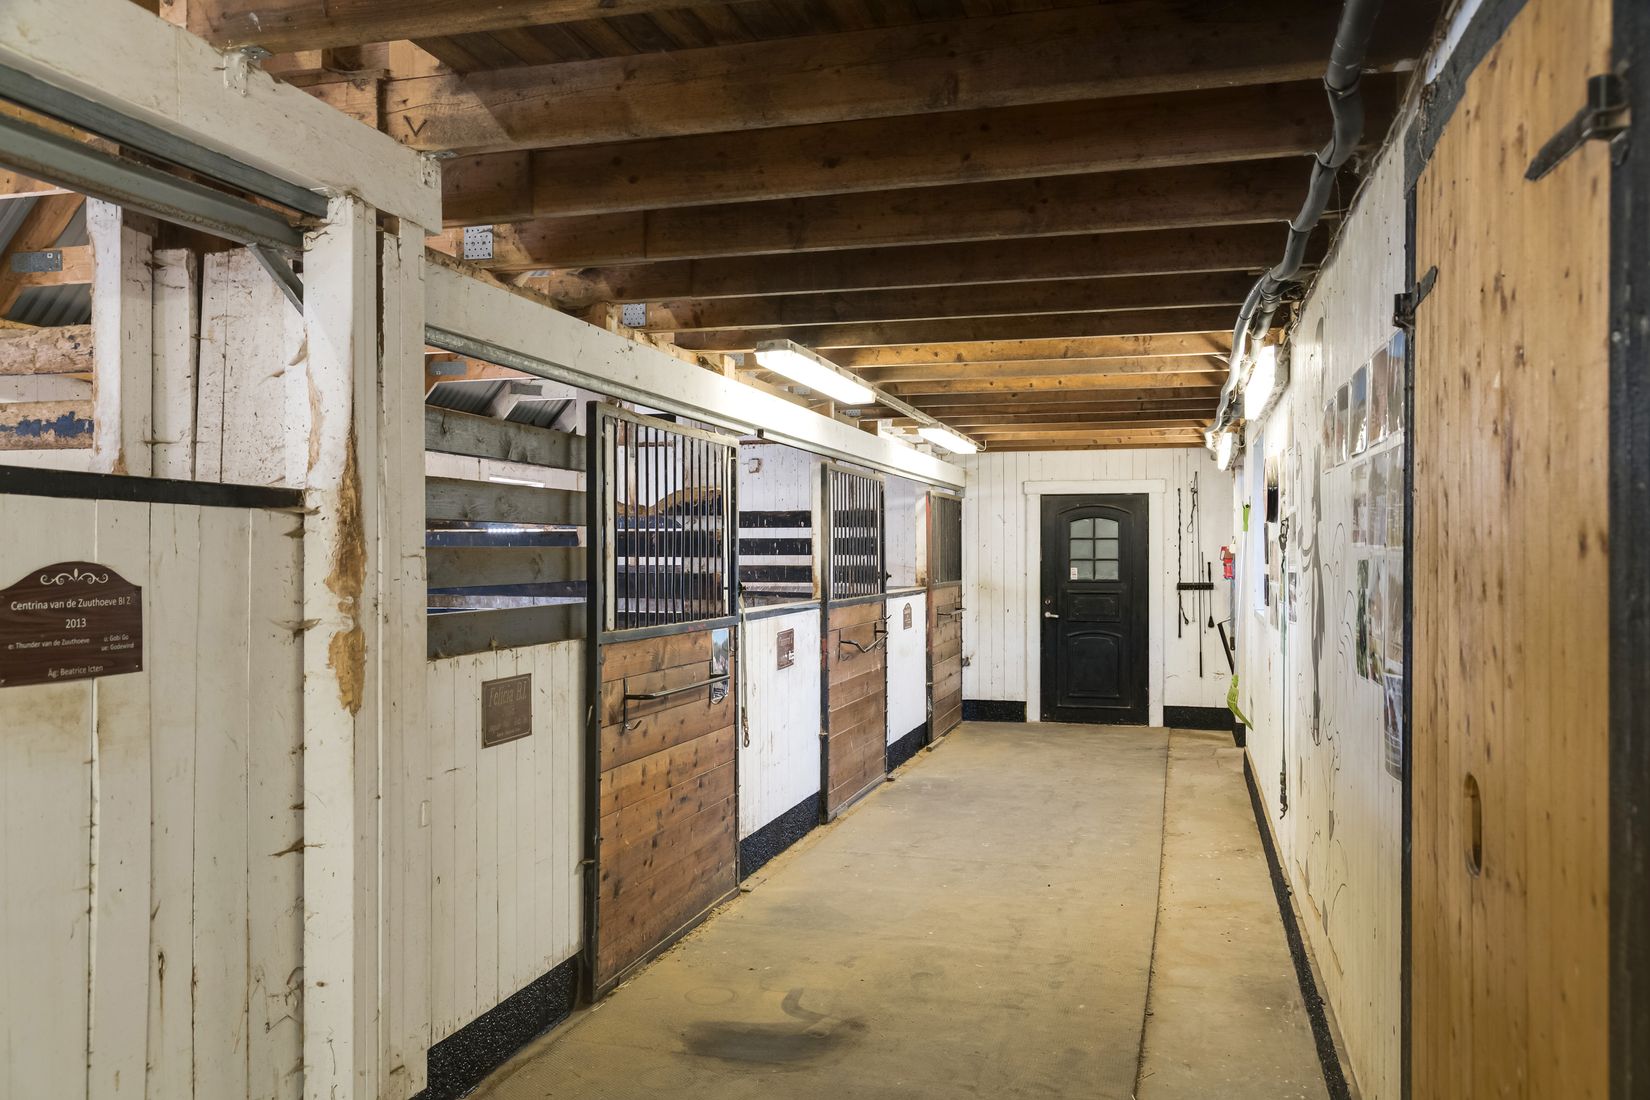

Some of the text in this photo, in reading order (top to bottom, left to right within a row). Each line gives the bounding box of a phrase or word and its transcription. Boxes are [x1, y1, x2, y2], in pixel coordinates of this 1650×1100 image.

[10, 600, 48, 611] Centrina
[49, 601, 65, 609] van
[66, 599, 77, 608] de
[78, 598, 117, 608] Zuuthoeve
[65, 618, 87, 629] 2013
[16, 640, 41, 649] Thunder
[61, 638, 91, 646] Zuuthoeve
[109, 634, 121, 642] Gobi
[60, 666, 87, 676] Beatrice
